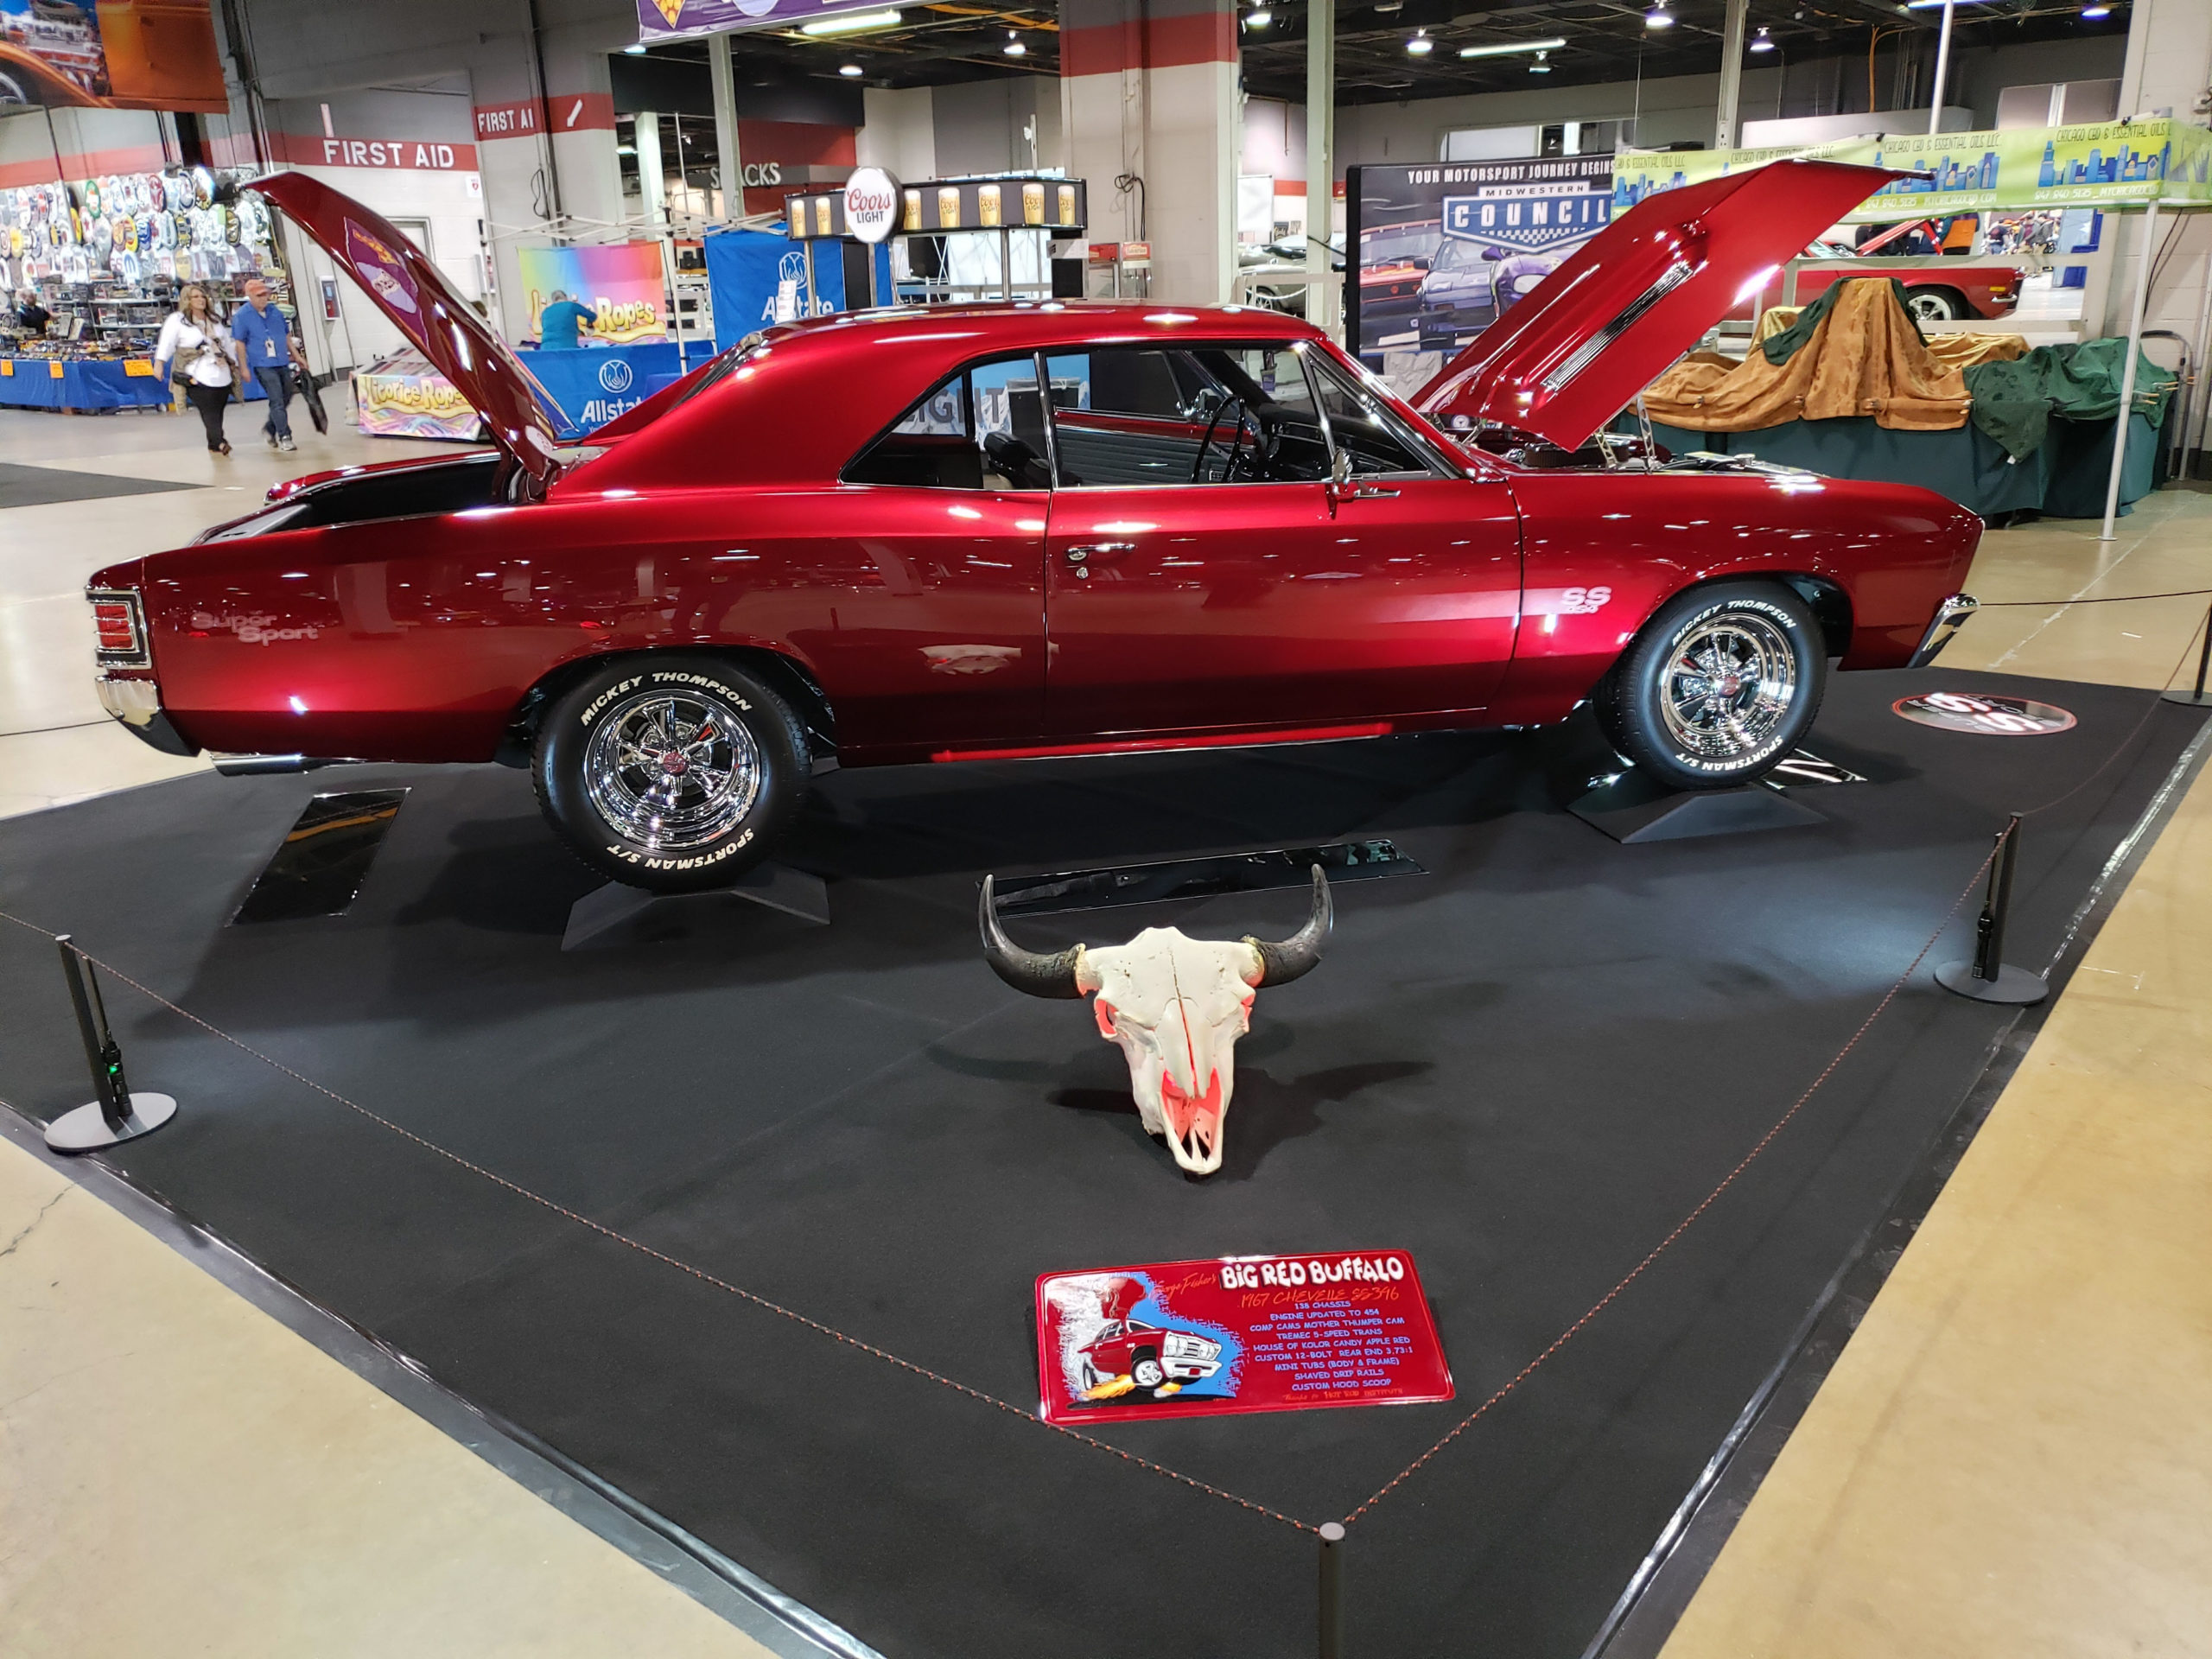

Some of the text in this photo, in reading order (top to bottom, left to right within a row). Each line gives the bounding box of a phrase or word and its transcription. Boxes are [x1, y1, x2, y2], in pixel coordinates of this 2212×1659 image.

[477, 110, 515, 133] FIRST
[2056, 129, 2085, 143] CHICAGO
[2112, 124, 2147, 140] ESSENTIAL
[2150, 122, 2165, 137] OILS
[322, 139, 454, 168] FIRST AID
[1885, 140, 1910, 154] CHICAGO
[1935, 136, 1967, 151] ESSENTIAL
[1408, 159, 1615, 185] YOUR MOTORSPORT JOURNEY BEGINS
[1632, 156, 1658, 169] ESSENTIAL
[710, 162, 781, 188] SCKS
[848, 188, 892, 212] Coors
[1485, 184, 1585, 198] MIDWESTERN
[857, 210, 884, 224] LIGHT
[1454, 198, 1606, 229] COUNCIL
[594, 296, 656, 333] Ropes
[1561, 586, 1612, 606] SS
[191, 611, 277, 633] Super
[1672, 600, 1796, 646] MICKEY THOMPSON
[238, 625, 319, 646] Sport
[581, 671, 753, 727] MICKEY THOMPSON
[1675, 735, 1783, 771] SPORTSMAN S/T
[607, 828, 754, 870] SPORTSMAN S/T
[1261, 1260, 1306, 1287] RED
[1307, 1255, 1405, 1285] BUFFALO
[1241, 1292, 1268, 1309] 1967
[1273, 1288, 1349, 1305] CHEVELLE
[1313, 1300, 1351, 1309] CHASSIS
[1249, 1324, 1273, 1332] COMP
[1276, 1322, 1301, 1331] CAMS
[1304, 1320, 1340, 1329] MOTHER
[1342, 1318, 1382, 1327] THUMPER
[1269, 1312, 1304, 1321] ENGINE
[1306, 1310, 1346, 1319] UPDATED
[1253, 1343, 1284, 1351] HOUSE
[1287, 1342, 1298, 1351] OF
[1301, 1340, 1331, 1349] KOLOR
[1333, 1338, 1363, 1347] CANDY
[1366, 1337, 1390, 1345] APPLE
[1276, 1327, 1383, 1340] TREMEC 5-SPEED TRANS
[1255, 1353, 1293, 1362] CUSTOM
[1295, 1350, 1333, 1360] 12-BOLT
[1364, 1347, 1383, 1356] END
[1386, 1345, 1414, 1355] 3.73:1
[1274, 1357, 1401, 1371] MINI TUBS (BODY & FRAME)
[1292, 1378, 1392, 1391] CUSTOM HOOD SCOOP
[1294, 1368, 1385, 1381] SHAVED DRIP RAILS
